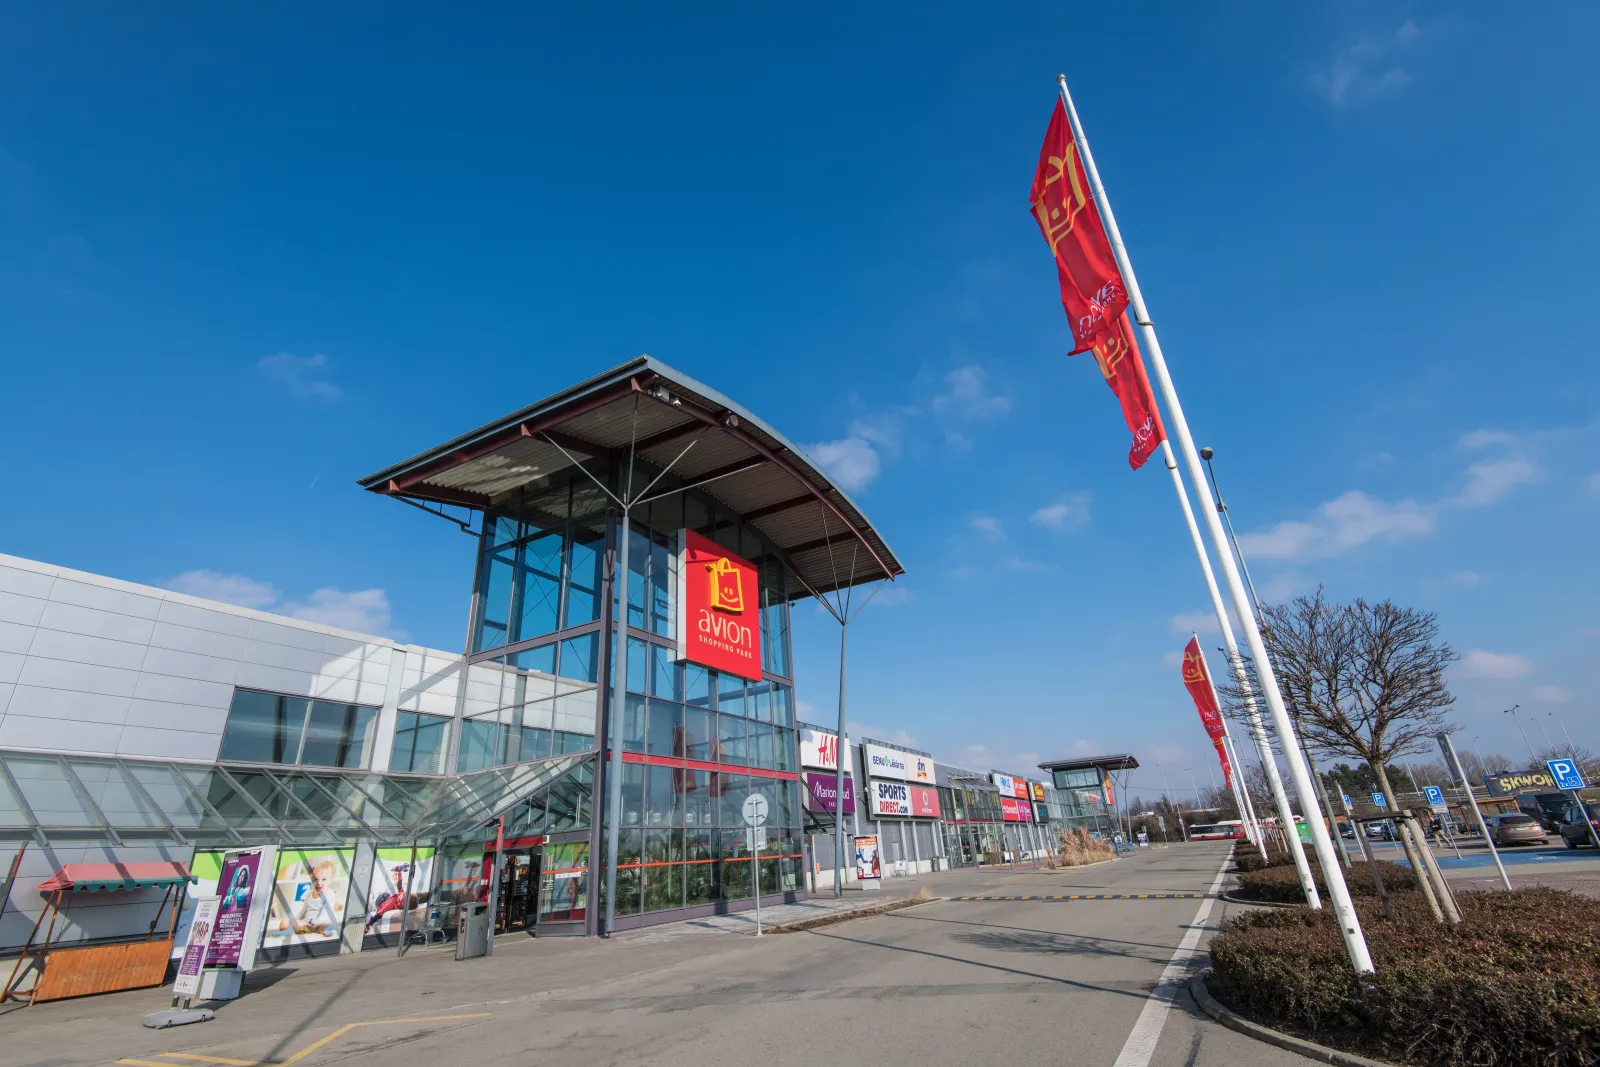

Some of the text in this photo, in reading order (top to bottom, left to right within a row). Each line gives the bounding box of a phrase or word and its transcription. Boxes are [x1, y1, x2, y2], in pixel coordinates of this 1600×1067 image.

[698, 608, 752, 649] avion
[698, 634, 753, 659] SHOPPING PARK
[1553, 763, 1571, 780] P
[812, 780, 850, 802] Marionud
[878, 783, 907, 801] SPORTS
[1374, 794, 1381, 802] P
[1428, 788, 1438, 799] P
